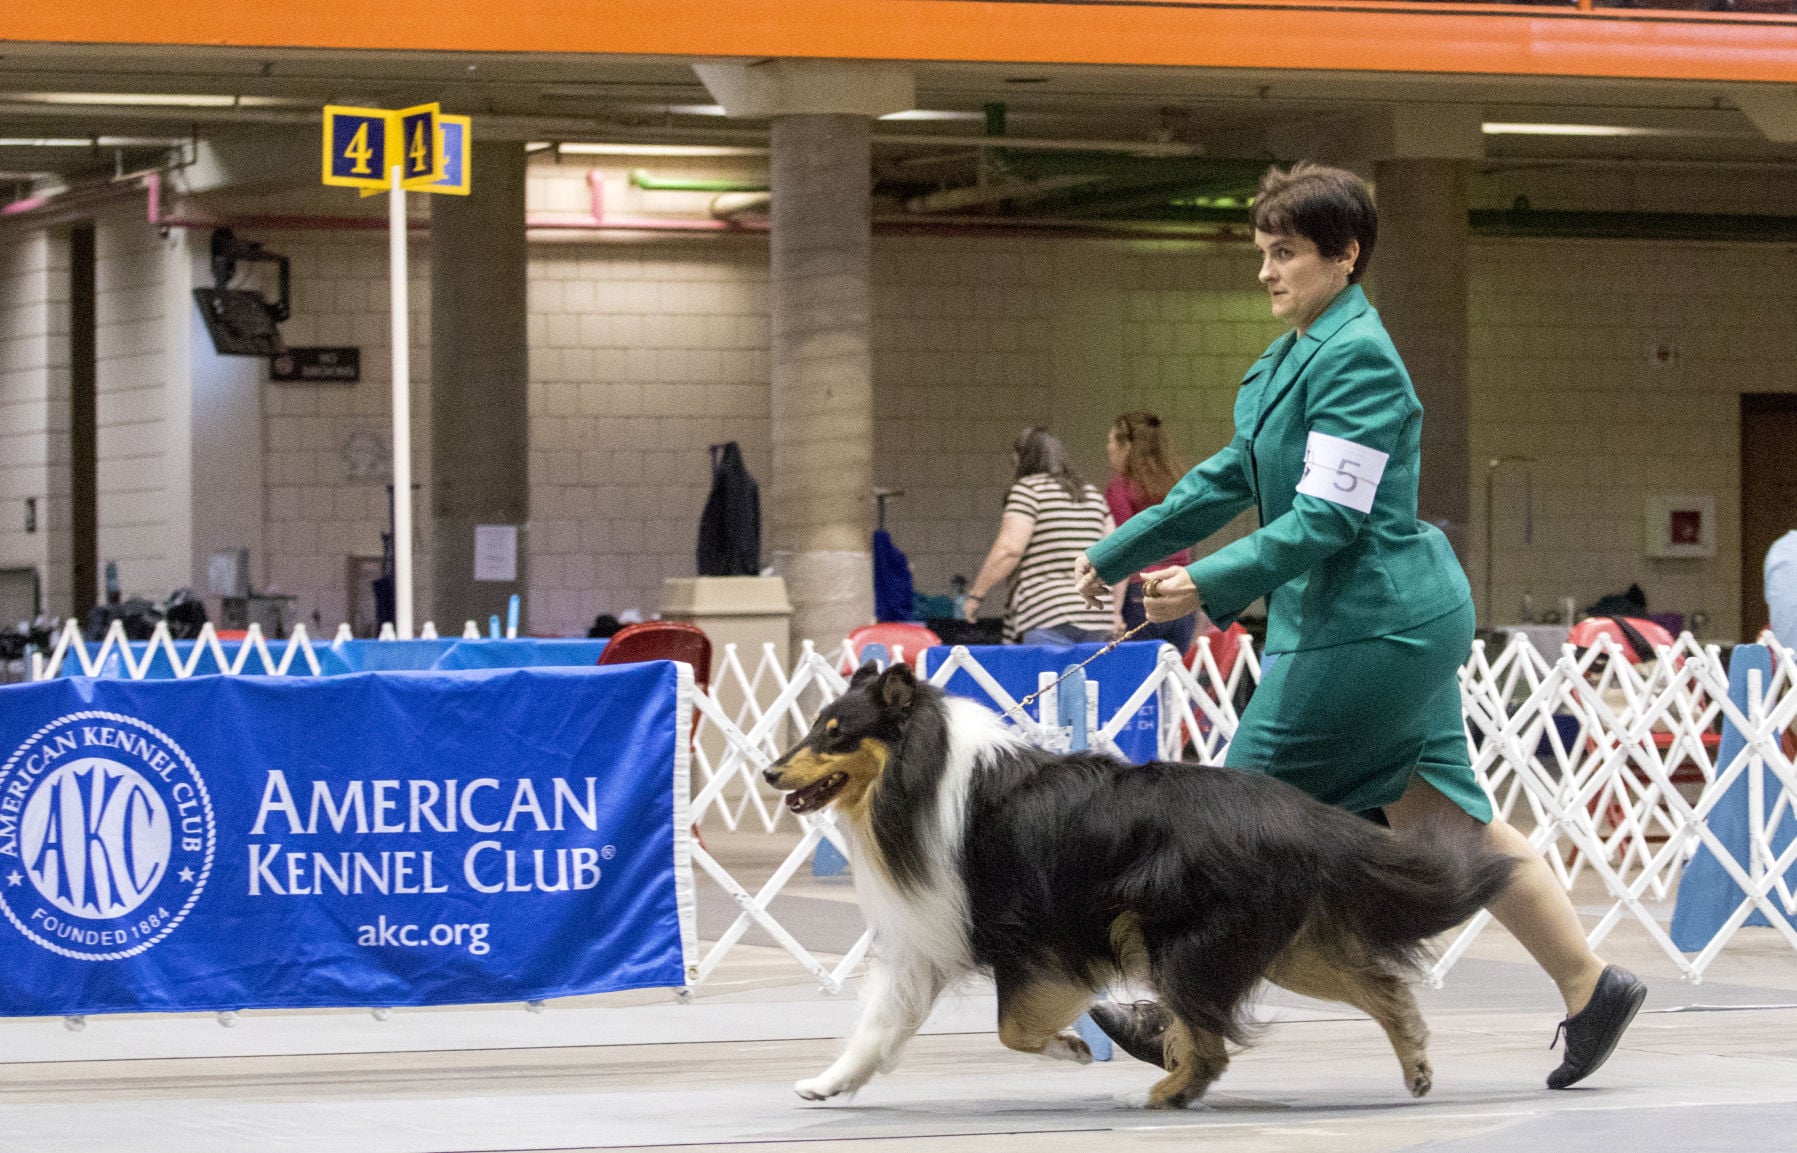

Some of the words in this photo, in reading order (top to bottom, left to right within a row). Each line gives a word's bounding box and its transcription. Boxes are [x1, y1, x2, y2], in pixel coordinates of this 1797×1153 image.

[343, 121, 373, 174] 4
[408, 119, 427, 172] 4
[1332, 458, 1361, 493] 5
[0, 730, 78, 858] AMERICAN
[82, 726, 179, 783] KENNEL
[172, 782, 203, 852] CLUB
[248, 769, 598, 835] AMERICAN
[31, 764, 160, 915] AKC
[247, 843, 449, 896] KENNEL
[31, 907, 128, 946] FOUNDED
[131, 906, 170, 939] 1884
[357, 915, 490, 955] akc.org
